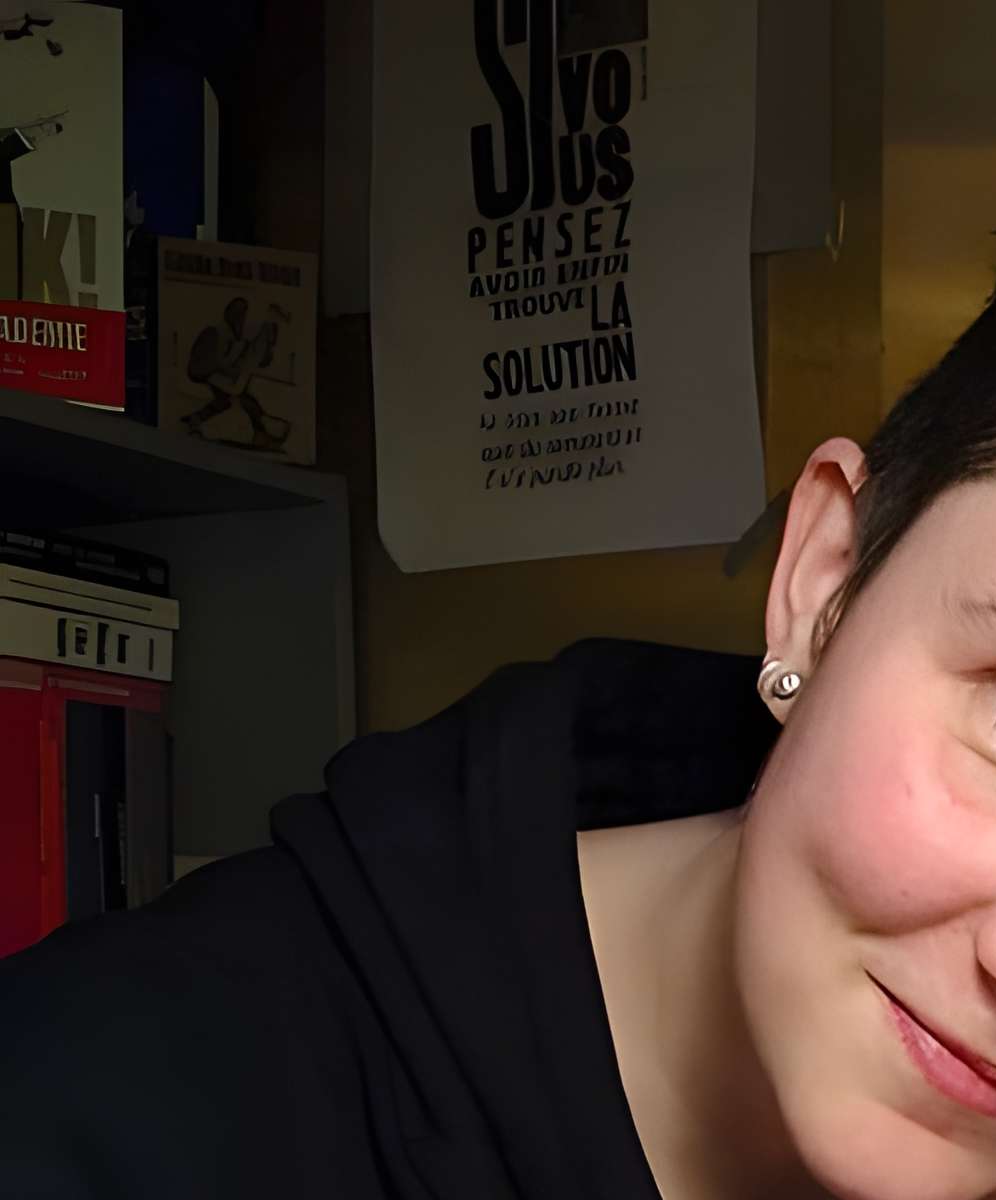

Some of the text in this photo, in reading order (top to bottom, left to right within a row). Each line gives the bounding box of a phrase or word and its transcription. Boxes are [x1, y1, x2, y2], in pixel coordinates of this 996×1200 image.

[467, 199, 632, 274] PENSEZ
[591, 281, 633, 331] LA
[482, 331, 637, 401] SOLUTION
